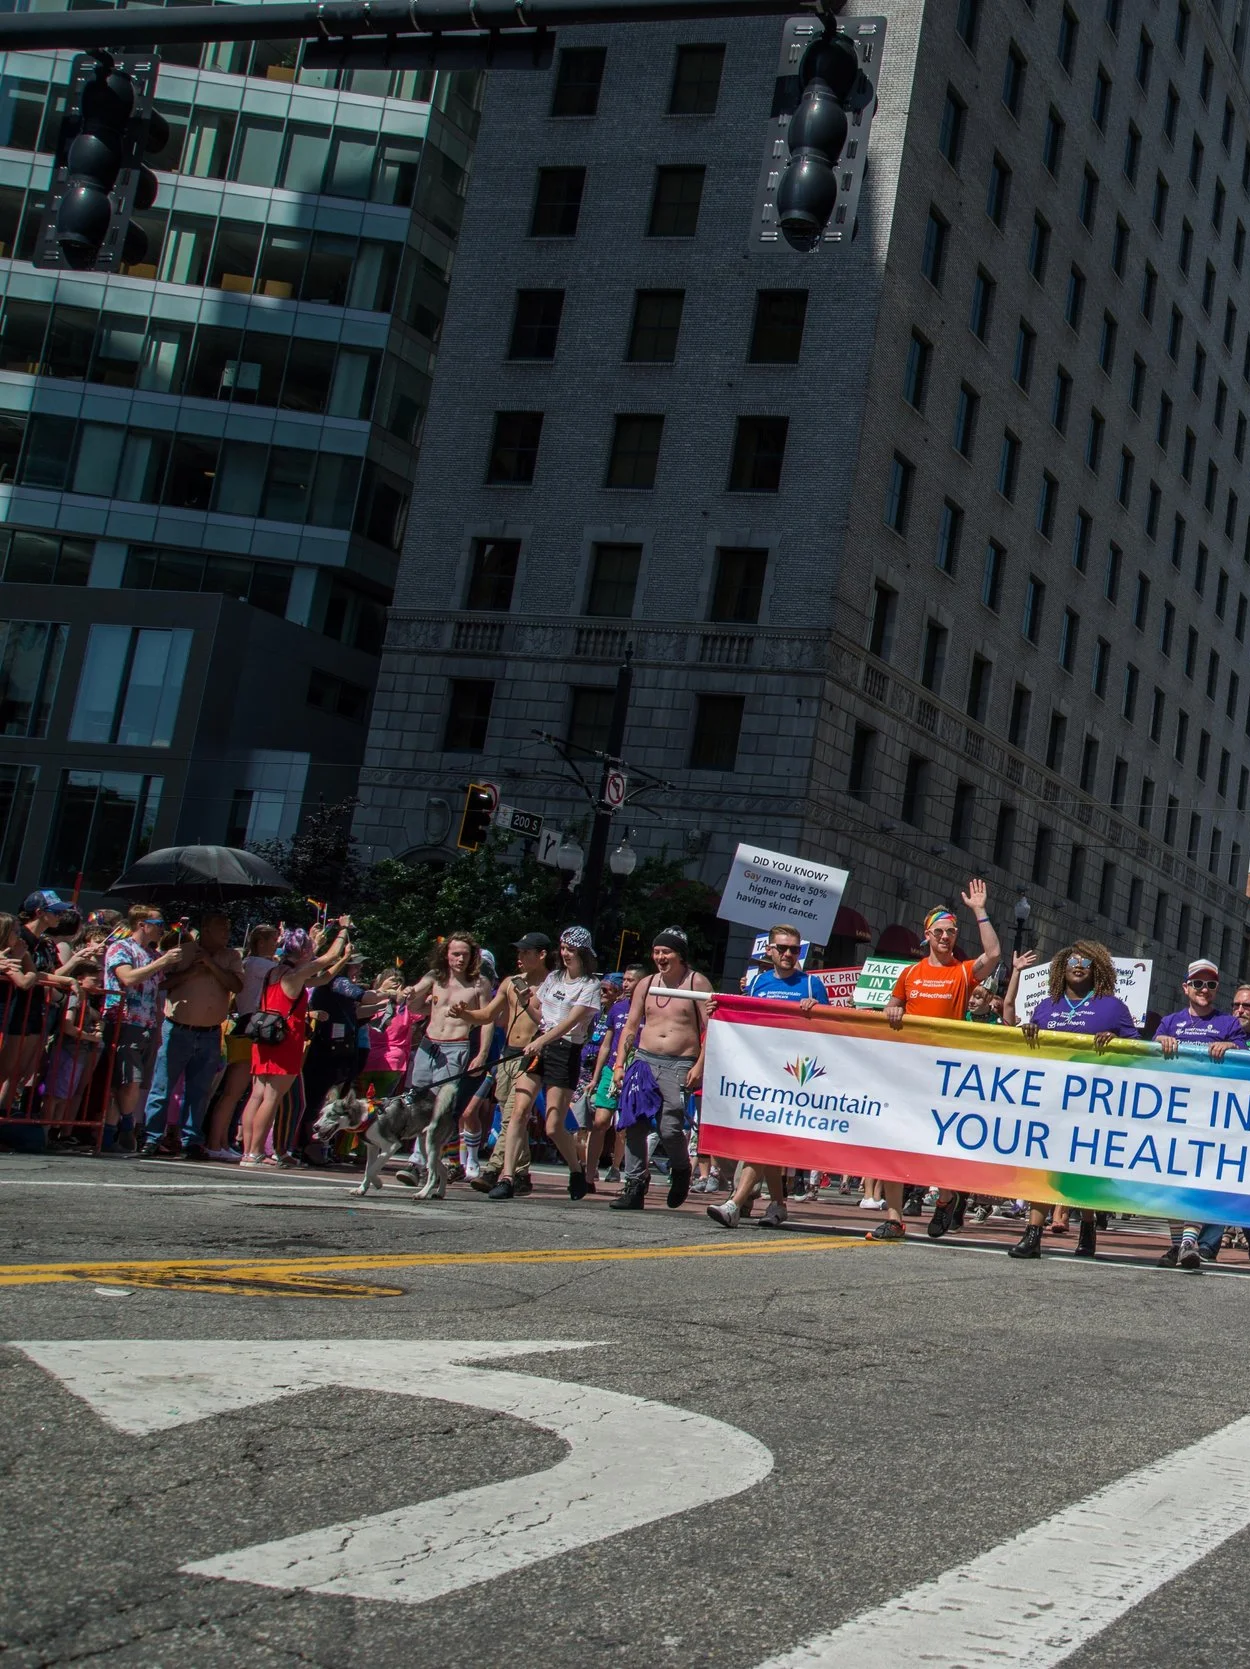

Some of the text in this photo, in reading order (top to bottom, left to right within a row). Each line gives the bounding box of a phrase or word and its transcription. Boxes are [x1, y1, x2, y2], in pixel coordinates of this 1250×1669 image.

[513, 814, 530, 828] 200
[531, 820, 538, 831] S
[752, 855, 829, 882] DID YOU KNOW?
[743, 869, 828, 899] Gay men have 50%
[748, 882, 814, 907] higher odds of
[735, 891, 818, 921] having skin cancer.
[839, 972, 861, 983] PRID
[867, 963, 899, 975] TAKE
[1024, 972, 1035, 981] DID
[832, 986, 854, 996] YOU
[869, 977, 884, 988] IN
[866, 991, 892, 1002] HEA
[1026, 989, 1046, 1001] people
[720, 1075, 883, 1117] Intermountain
[935, 1059, 1046, 1108] TAKE
[1061, 1074, 1191, 1124] PRIDE
[739, 1102, 850, 1133] Healthcare
[930, 1108, 1248, 1183] YOUR HEALTH
